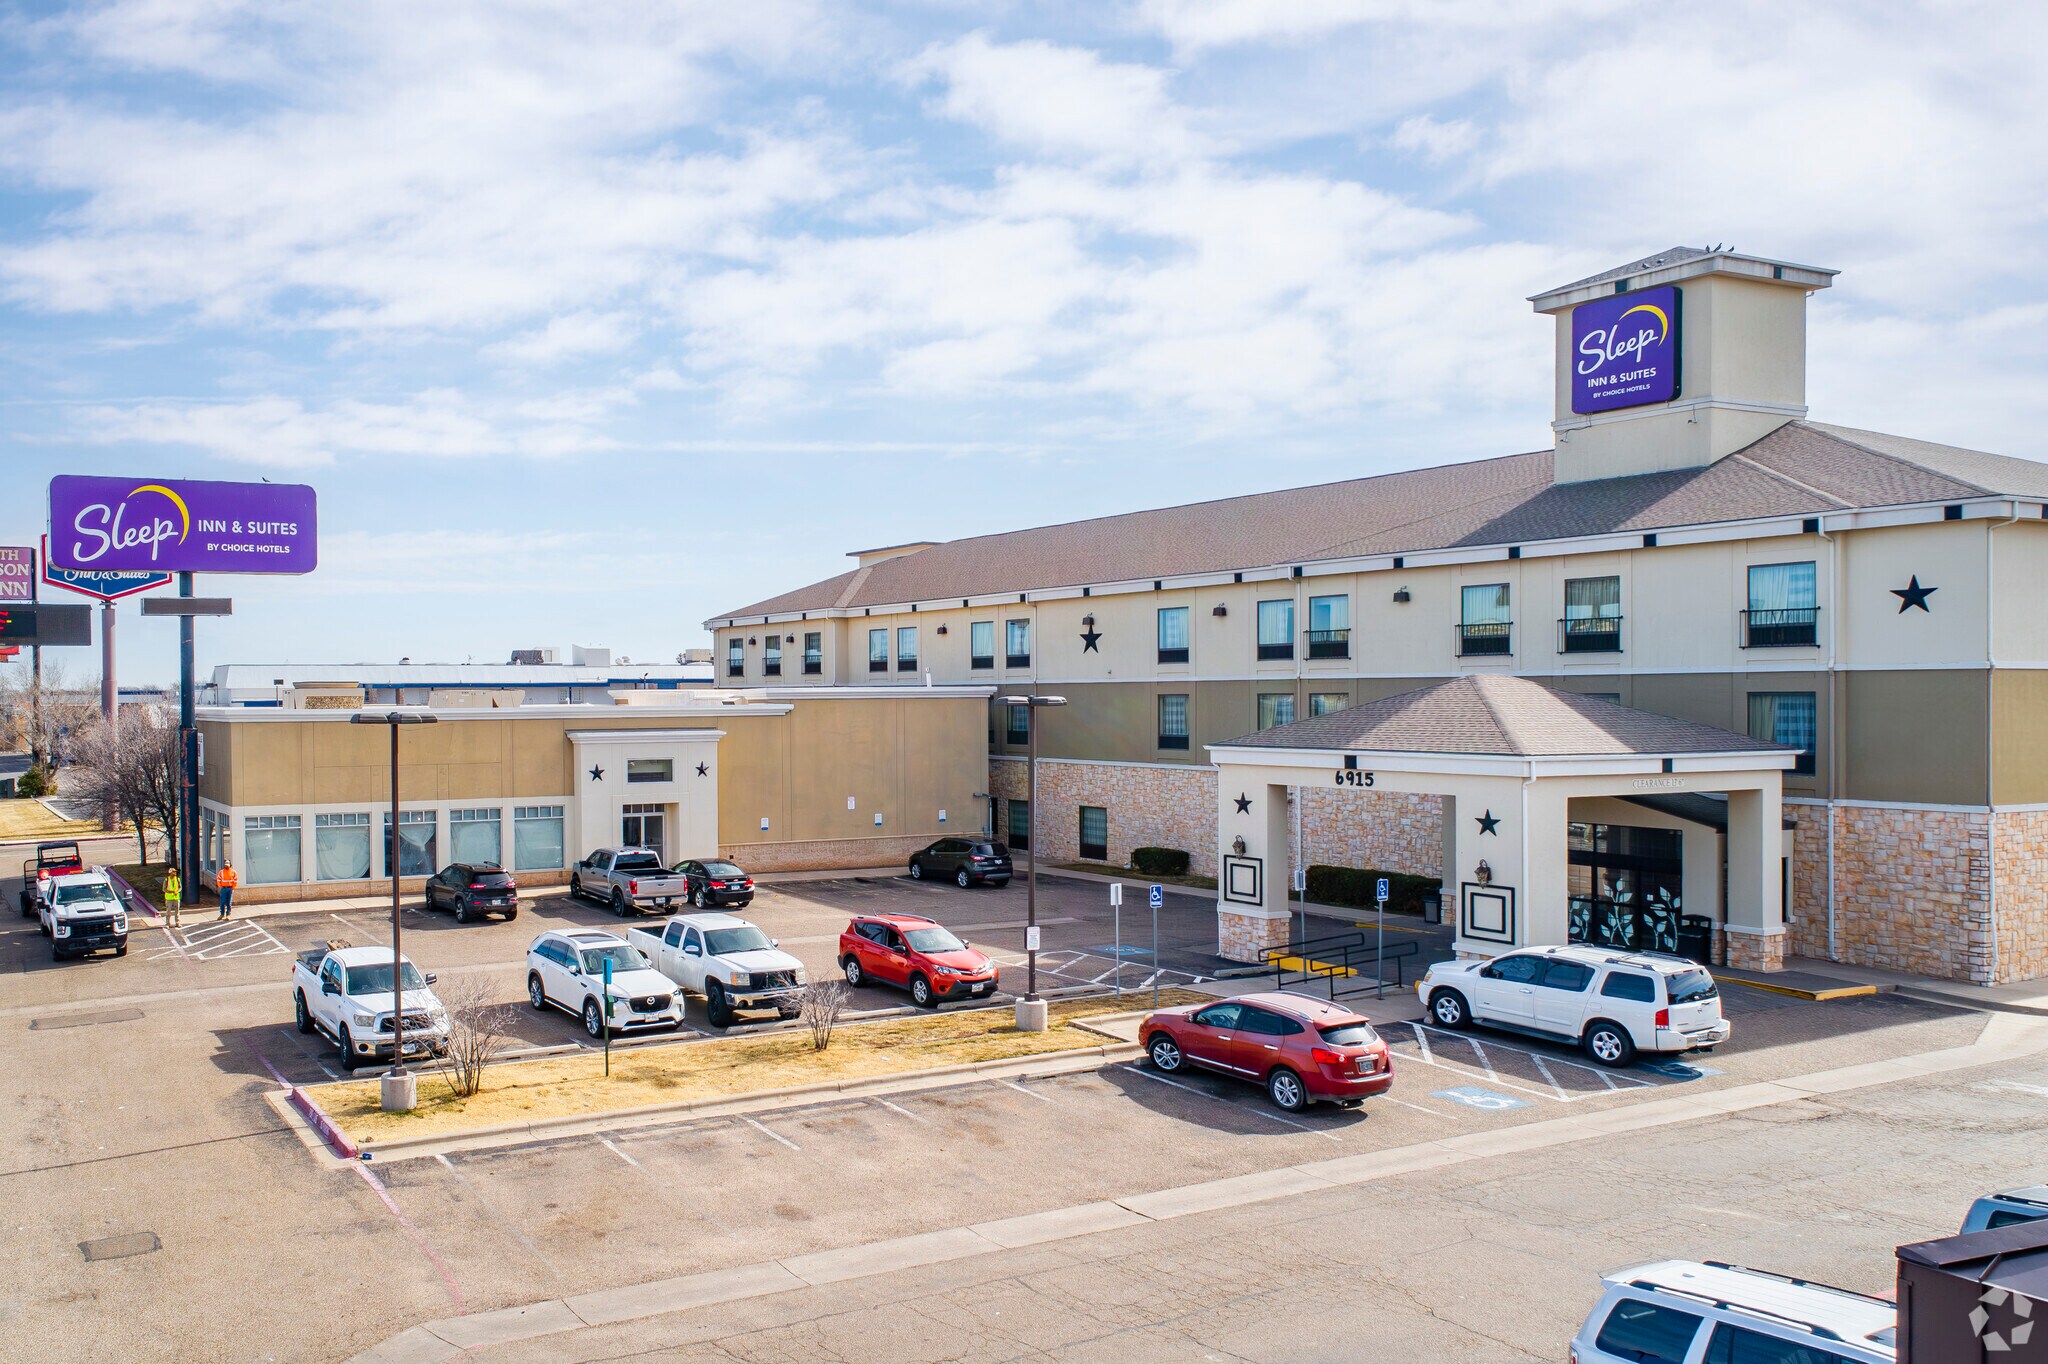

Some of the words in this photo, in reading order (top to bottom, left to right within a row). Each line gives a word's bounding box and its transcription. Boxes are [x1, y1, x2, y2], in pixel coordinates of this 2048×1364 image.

[1577, 324, 1659, 375] Sleep
[1587, 376, 1608, 388] INN
[1609, 374, 1618, 384] &
[1619, 367, 1657, 383] SUITES
[1602, 387, 1625, 397] CHOICE
[1626, 383, 1651, 393] HOTELS
[72, 502, 179, 563] Sleep
[198, 519, 227, 533] INN
[232, 520, 243, 534] &
[247, 521, 298, 536] SUITES
[207, 543, 220, 551] BY
[221, 543, 255, 553] CHOICE
[256, 544, 290, 554] HOTELS
[1335, 770, 1374, 787] 6915
[1632, 778, 1671, 789] CLEARANCE
